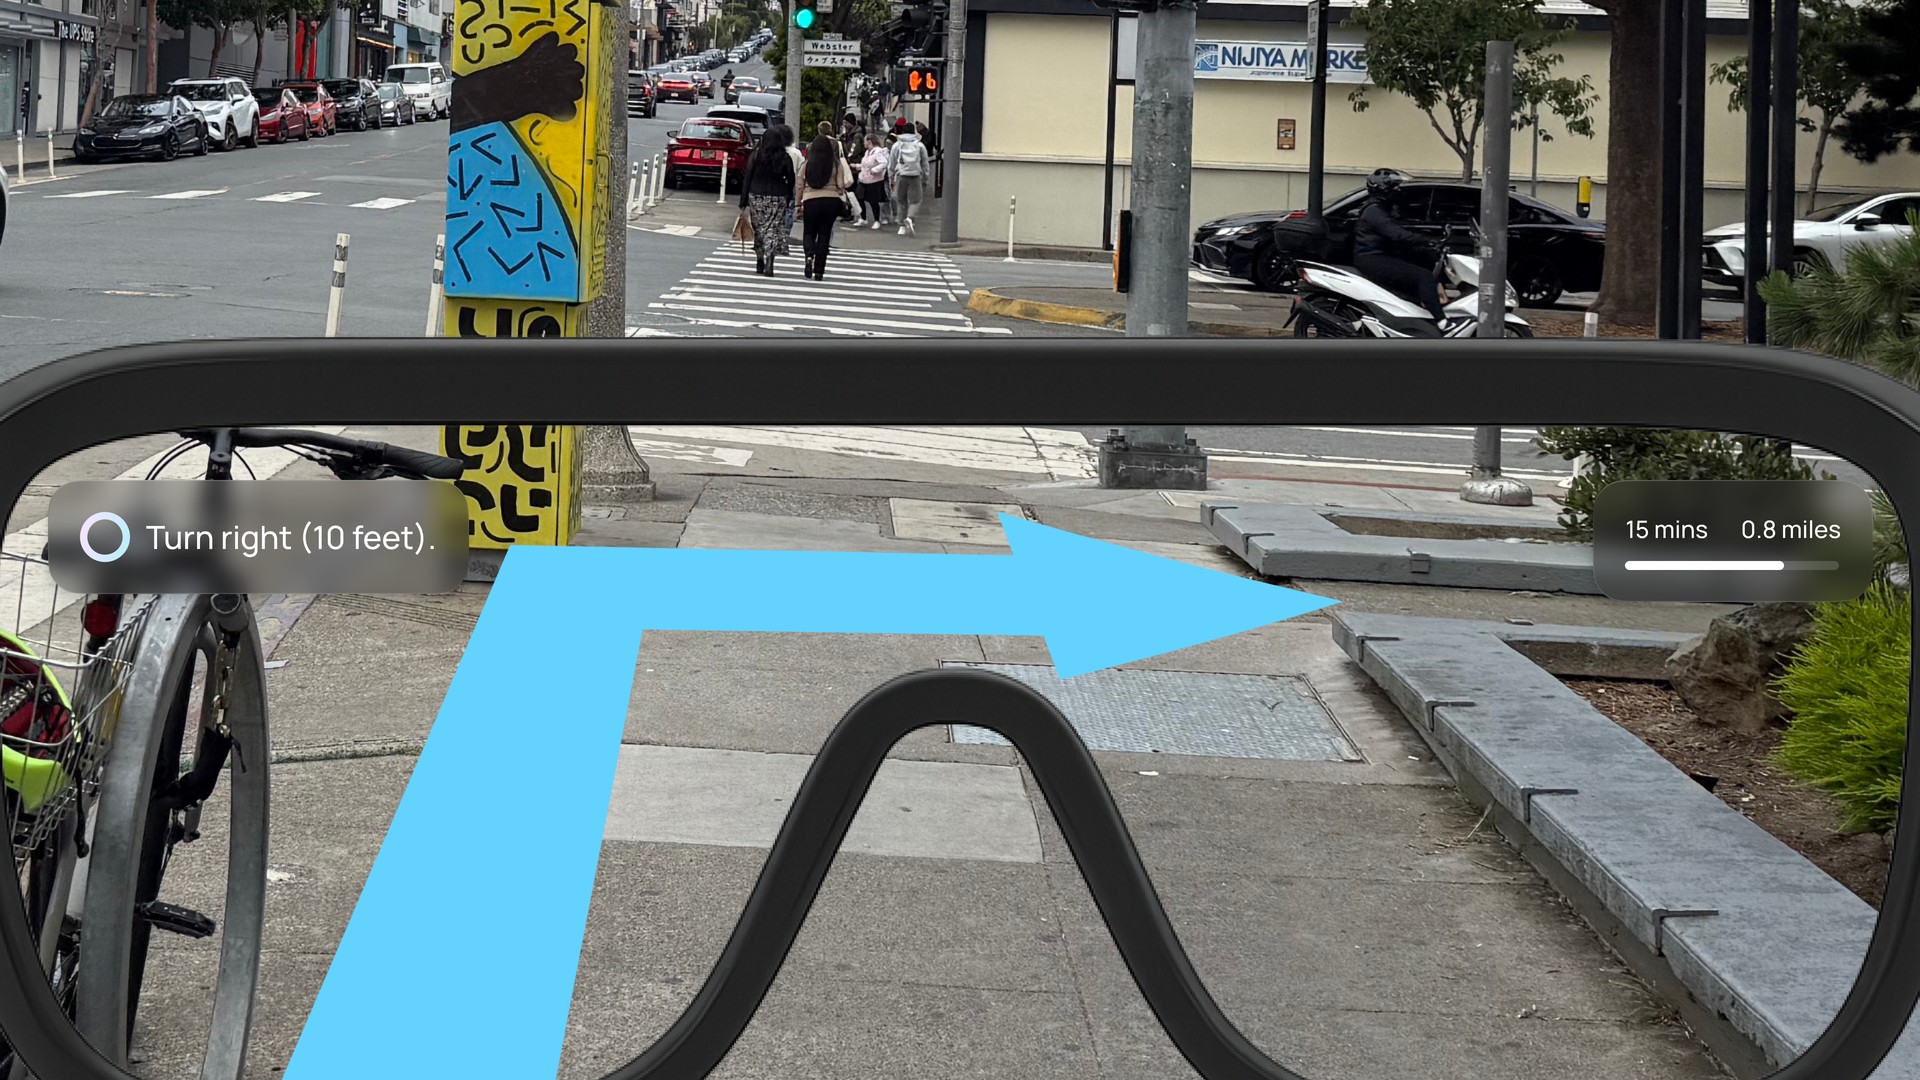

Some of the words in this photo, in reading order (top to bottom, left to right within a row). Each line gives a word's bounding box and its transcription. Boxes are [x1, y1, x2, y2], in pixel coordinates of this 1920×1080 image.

[59, 21, 68, 40] The
[70, 23, 80, 40] UPS
[81, 25, 94, 43] Store
[812, 42, 853, 51] Webster
[1222, 46, 1287, 68] NIJIYA
[1290, 47, 1367, 70] MRKE
